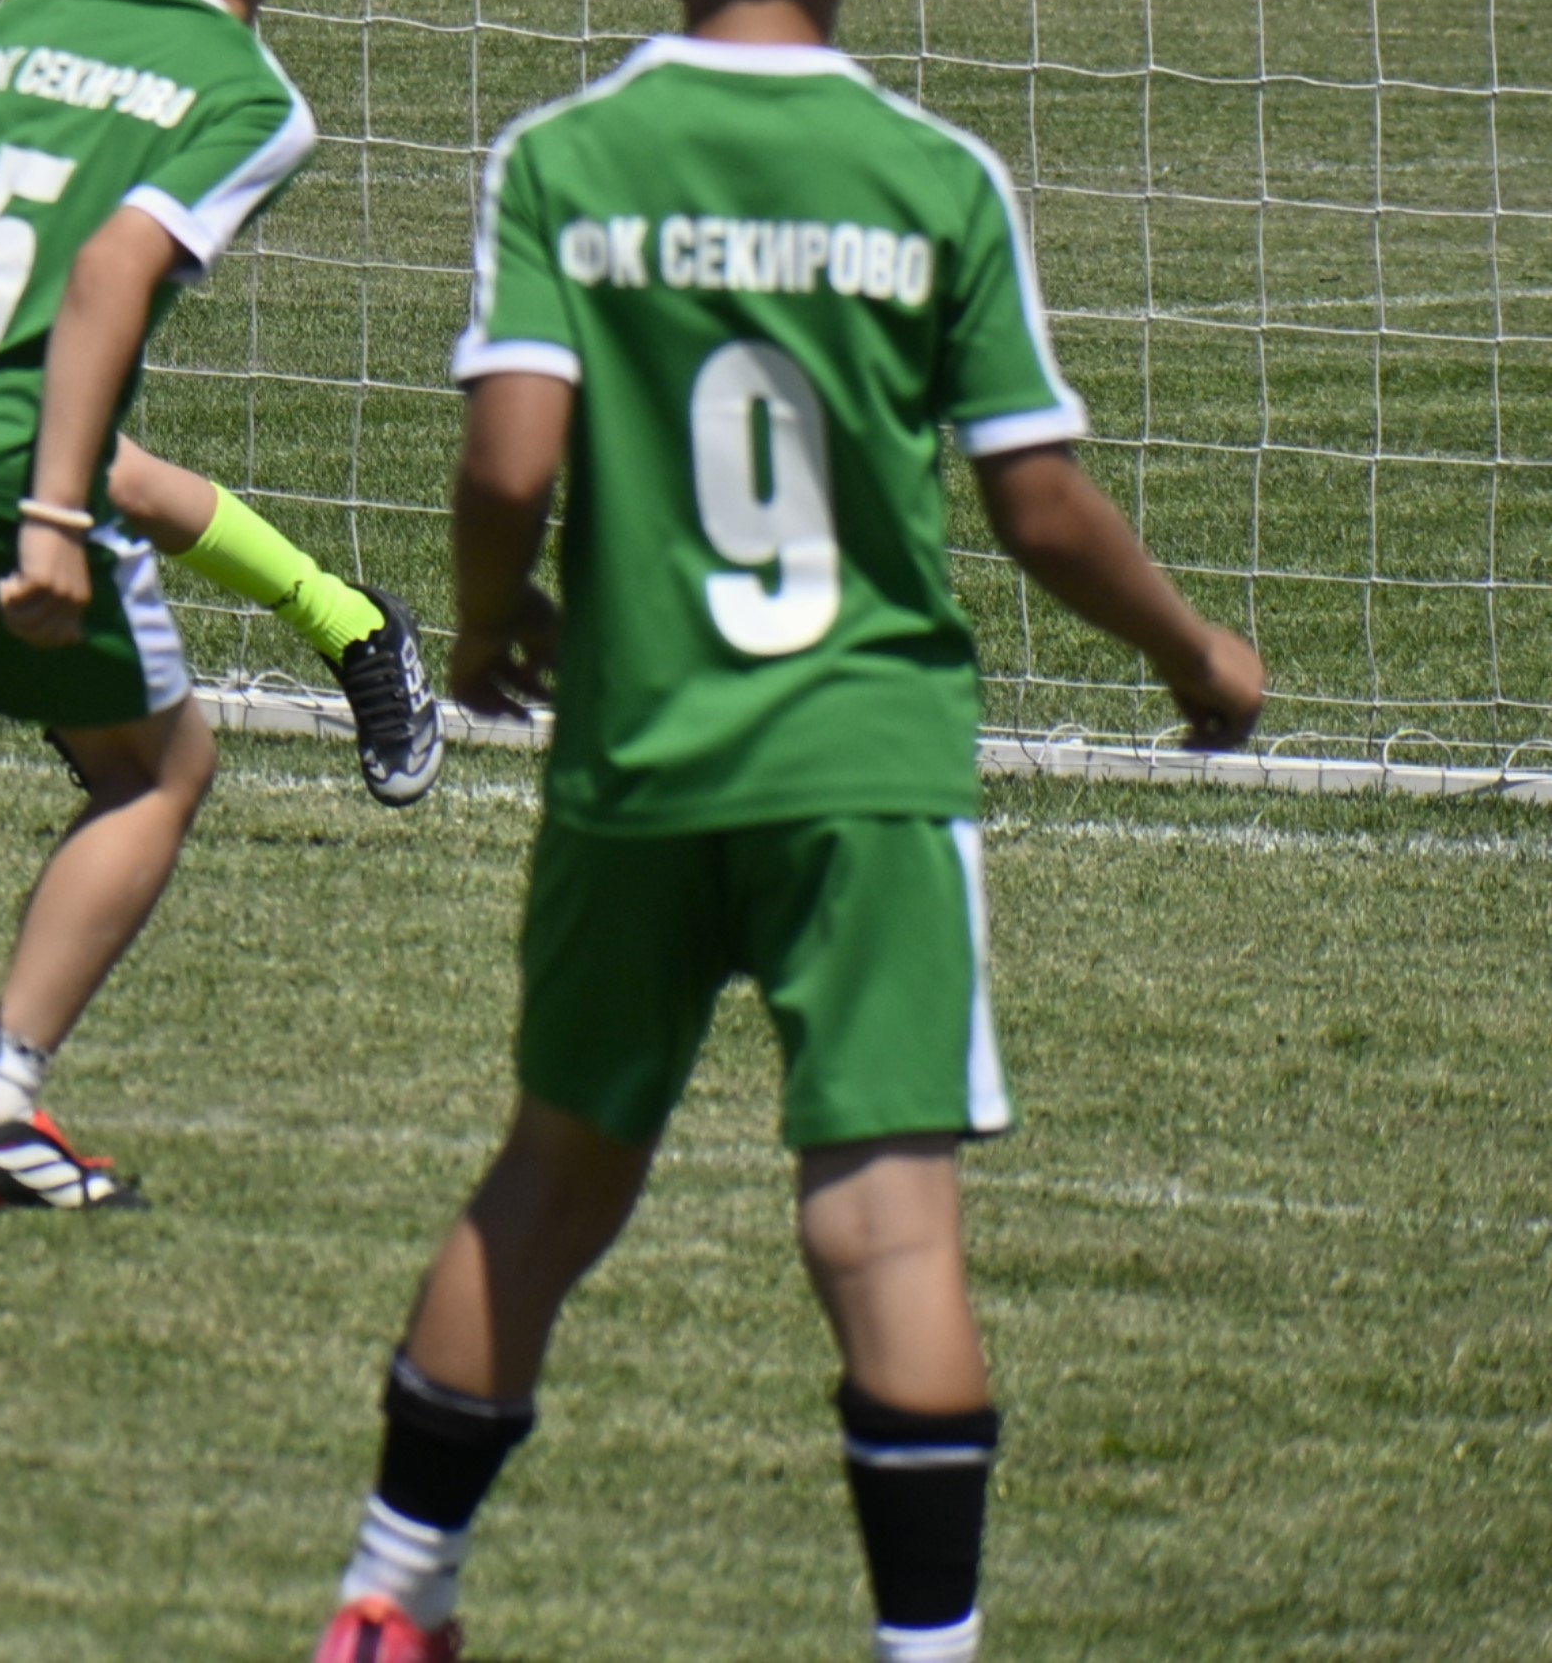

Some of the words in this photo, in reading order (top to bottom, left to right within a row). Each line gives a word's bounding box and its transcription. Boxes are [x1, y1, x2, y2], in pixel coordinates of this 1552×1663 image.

[559, 215, 650, 288] ФК
[659, 214, 934, 308] СЕКИРОВО
[690, 341, 840, 657] 9
